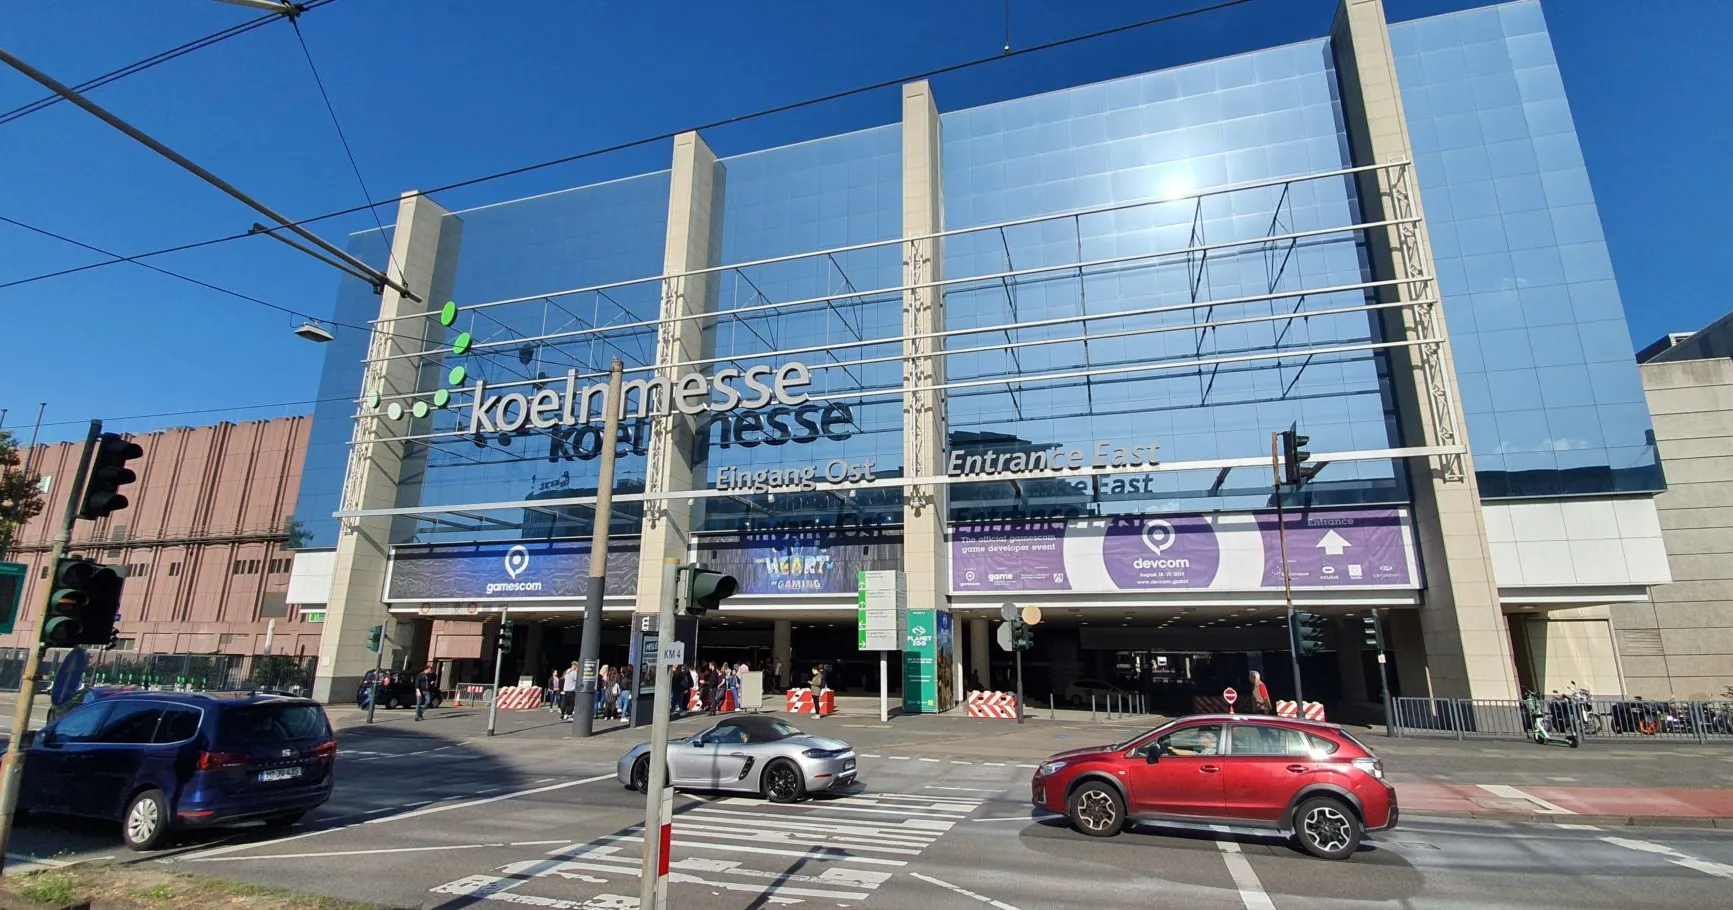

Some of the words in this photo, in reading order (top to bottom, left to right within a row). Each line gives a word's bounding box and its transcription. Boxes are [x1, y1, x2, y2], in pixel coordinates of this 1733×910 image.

[470, 361, 811, 435] koelnmesse
[947, 445, 1084, 477] Entrance
[1092, 440, 1160, 470] East
[716, 465, 817, 494] Eingang
[824, 457, 876, 485] Ost
[1307, 518, 1354, 527] Entrance
[978, 535, 1007, 543] official
[1009, 535, 1056, 545] gamescom
[961, 546, 986, 555] game
[988, 544, 1029, 554] developer
[1031, 543, 1056, 552] event
[1133, 558, 1189, 569] devcom
[988, 573, 1013, 582] game
[486, 582, 542, 594] gamescom
[777, 579, 821, 590] GAMING
[663, 649, 676, 659] KM
[676, 649, 682, 658] 4
